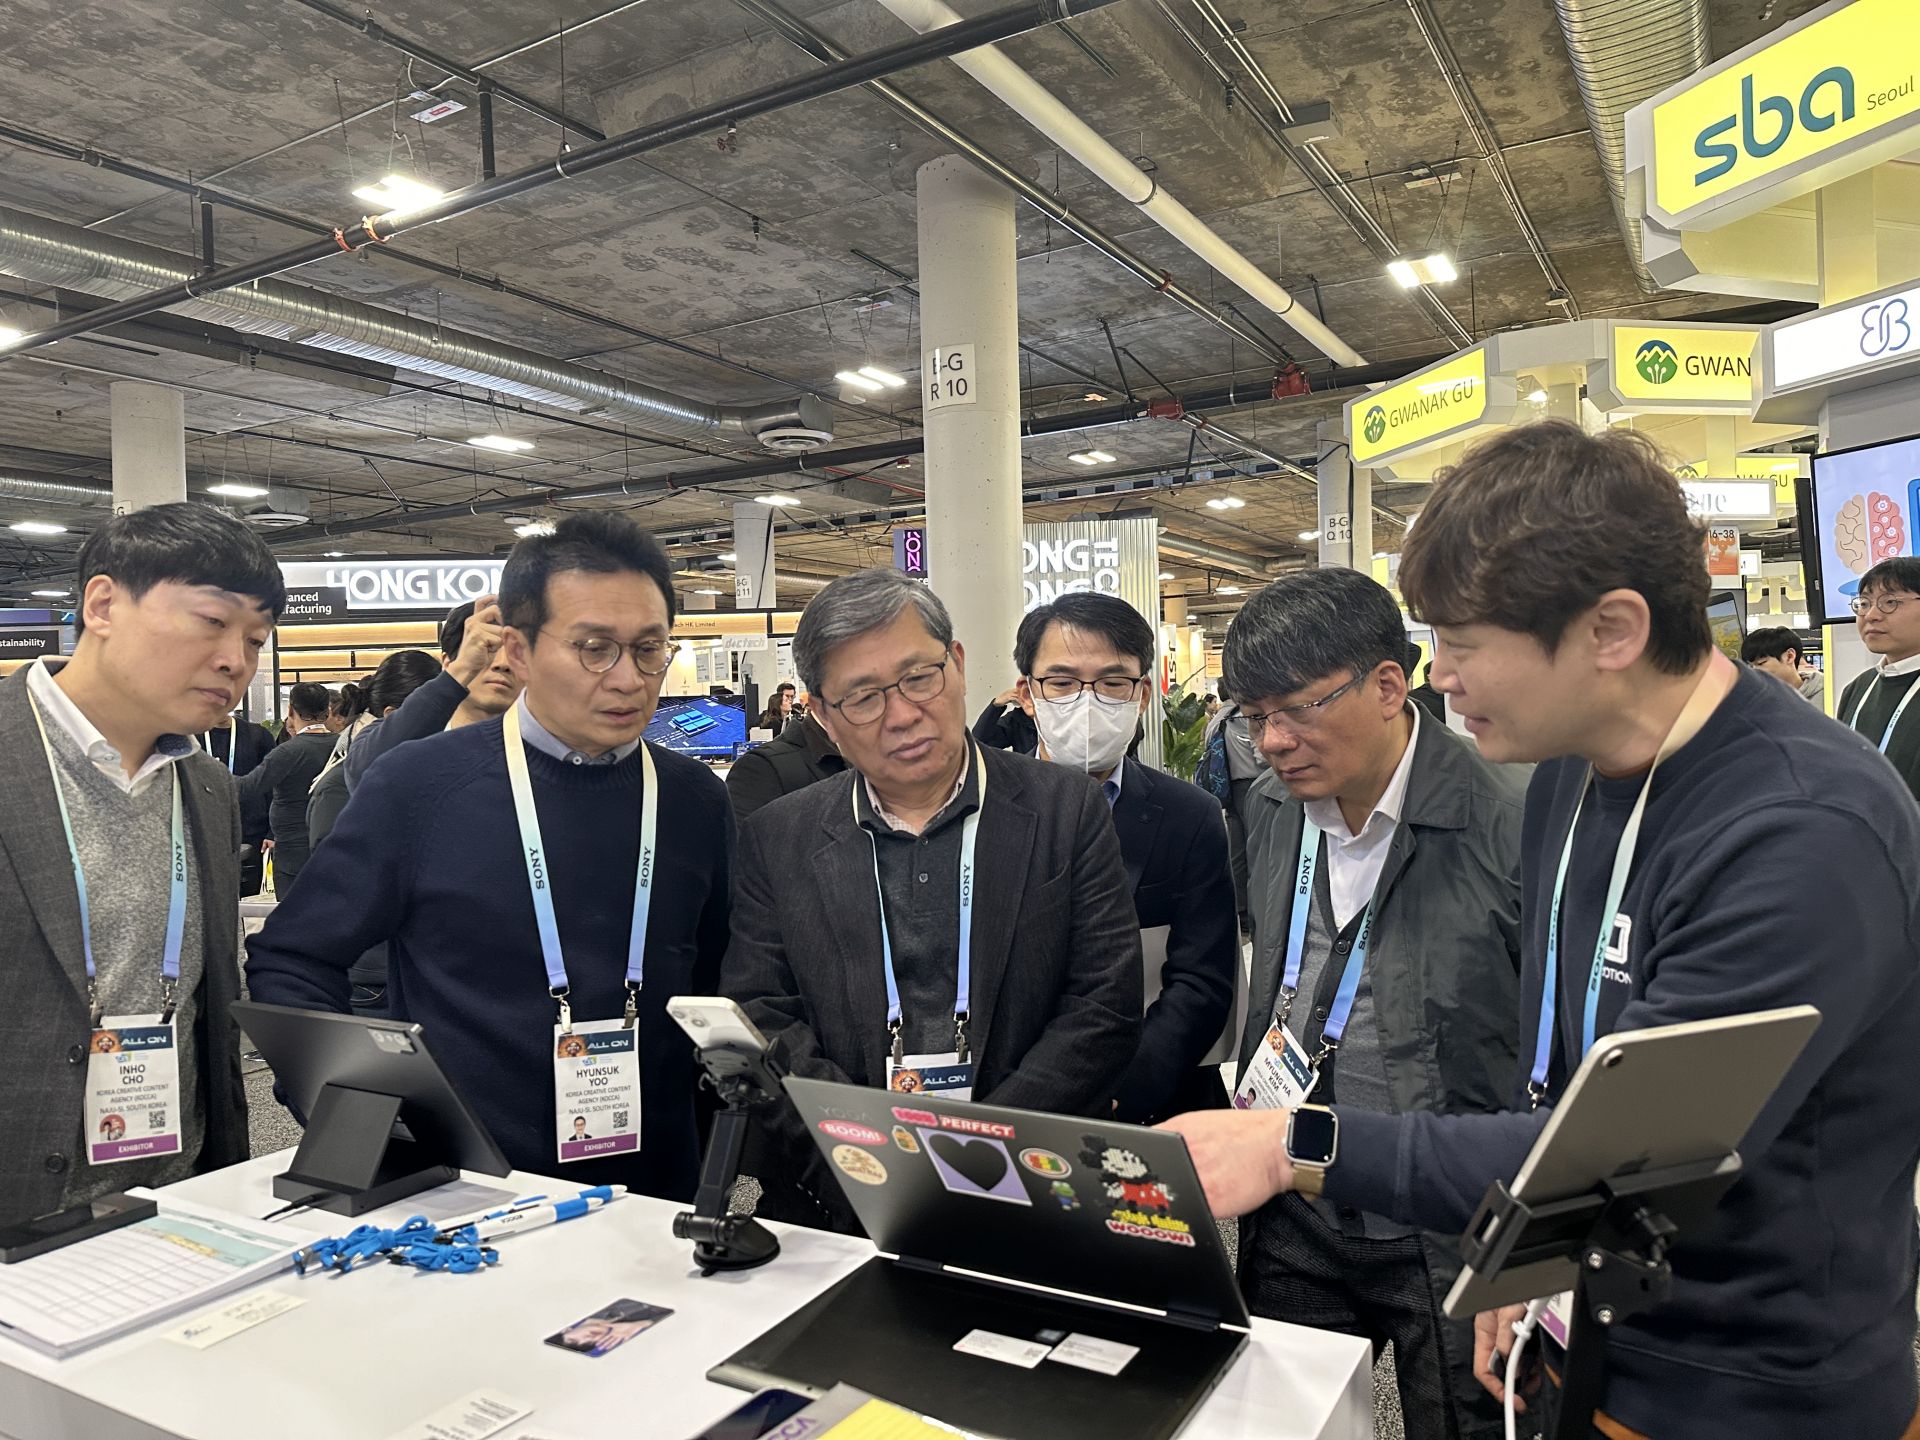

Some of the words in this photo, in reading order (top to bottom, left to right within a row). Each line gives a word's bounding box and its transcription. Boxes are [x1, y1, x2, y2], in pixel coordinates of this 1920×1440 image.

[1694, 66, 1856, 188] sba
[1866, 74, 1915, 111] Seoul
[1684, 355, 1751, 377] GWAN
[930, 382, 940, 401] R
[946, 377, 968, 397] 10
[1389, 389, 1449, 428] GWANAK
[1452, 378, 1474, 403] GU
[1329, 516, 1348, 528] B-G
[1326, 531, 1336, 541] Q
[1340, 529, 1352, 540] 10
[1021, 538, 1090, 574] ONG
[1093, 537, 1119, 598] TEC
[326, 568, 431, 601] HONG
[287, 591, 319, 602] anced
[742, 588, 751, 596] 11
[285, 603, 332, 615] facturing
[695, 620, 716, 628] Limited
[0, 638, 46, 648] stainability
[175, 840, 184, 882] SONY
[640, 846, 651, 888] SONY
[529, 847, 545, 890] SONY
[1299, 855, 1312, 895] SONY
[962, 864, 971, 907] SONY
[1358, 910, 1374, 951] SONY
[1591, 930, 1606, 992] SONY
[121, 1037, 146, 1046] ALL
[147, 1035, 167, 1044] ON
[587, 1042, 610, 1050] ALL
[611, 1039, 629, 1047] ON
[120, 1064, 146, 1075] INHO
[576, 1065, 619, 1078] HYUNSUK
[1264, 1057, 1283, 1085] MYUNG
[1283, 1052, 1295, 1070] ALL
[1295, 1068, 1306, 1084] ON
[122, 1075, 144, 1085] CHO
[589, 1077, 608, 1087] YOO
[923, 1077, 947, 1085] ALL
[948, 1075, 966, 1083] ON
[1268, 1076, 1279, 1092] KIM
[116, 1086, 142, 1094] CREATIVE
[143, 1084, 169, 1092] CONTENT
[565, 1090, 583, 1098] KOREA
[583, 1088, 607, 1096] CREATIVE
[608, 1085, 631, 1093] CONTENT
[126, 1103, 147, 1112] SOUTH
[148, 1101, 167, 1109] KOREA
[578, 1096, 599, 1104] AGENCY
[592, 1104, 612, 1112] SOUTH
[612, 1102, 630, 1110] KOREA
[824, 1123, 881, 1141] BOOM!
[940, 1116, 1013, 1137] PERFECT
[118, 1142, 154, 1153] EXHIBITOR
[584, 1141, 616, 1152] EXHIBITOR
[1108, 1220, 1192, 1243] WOOOW!
